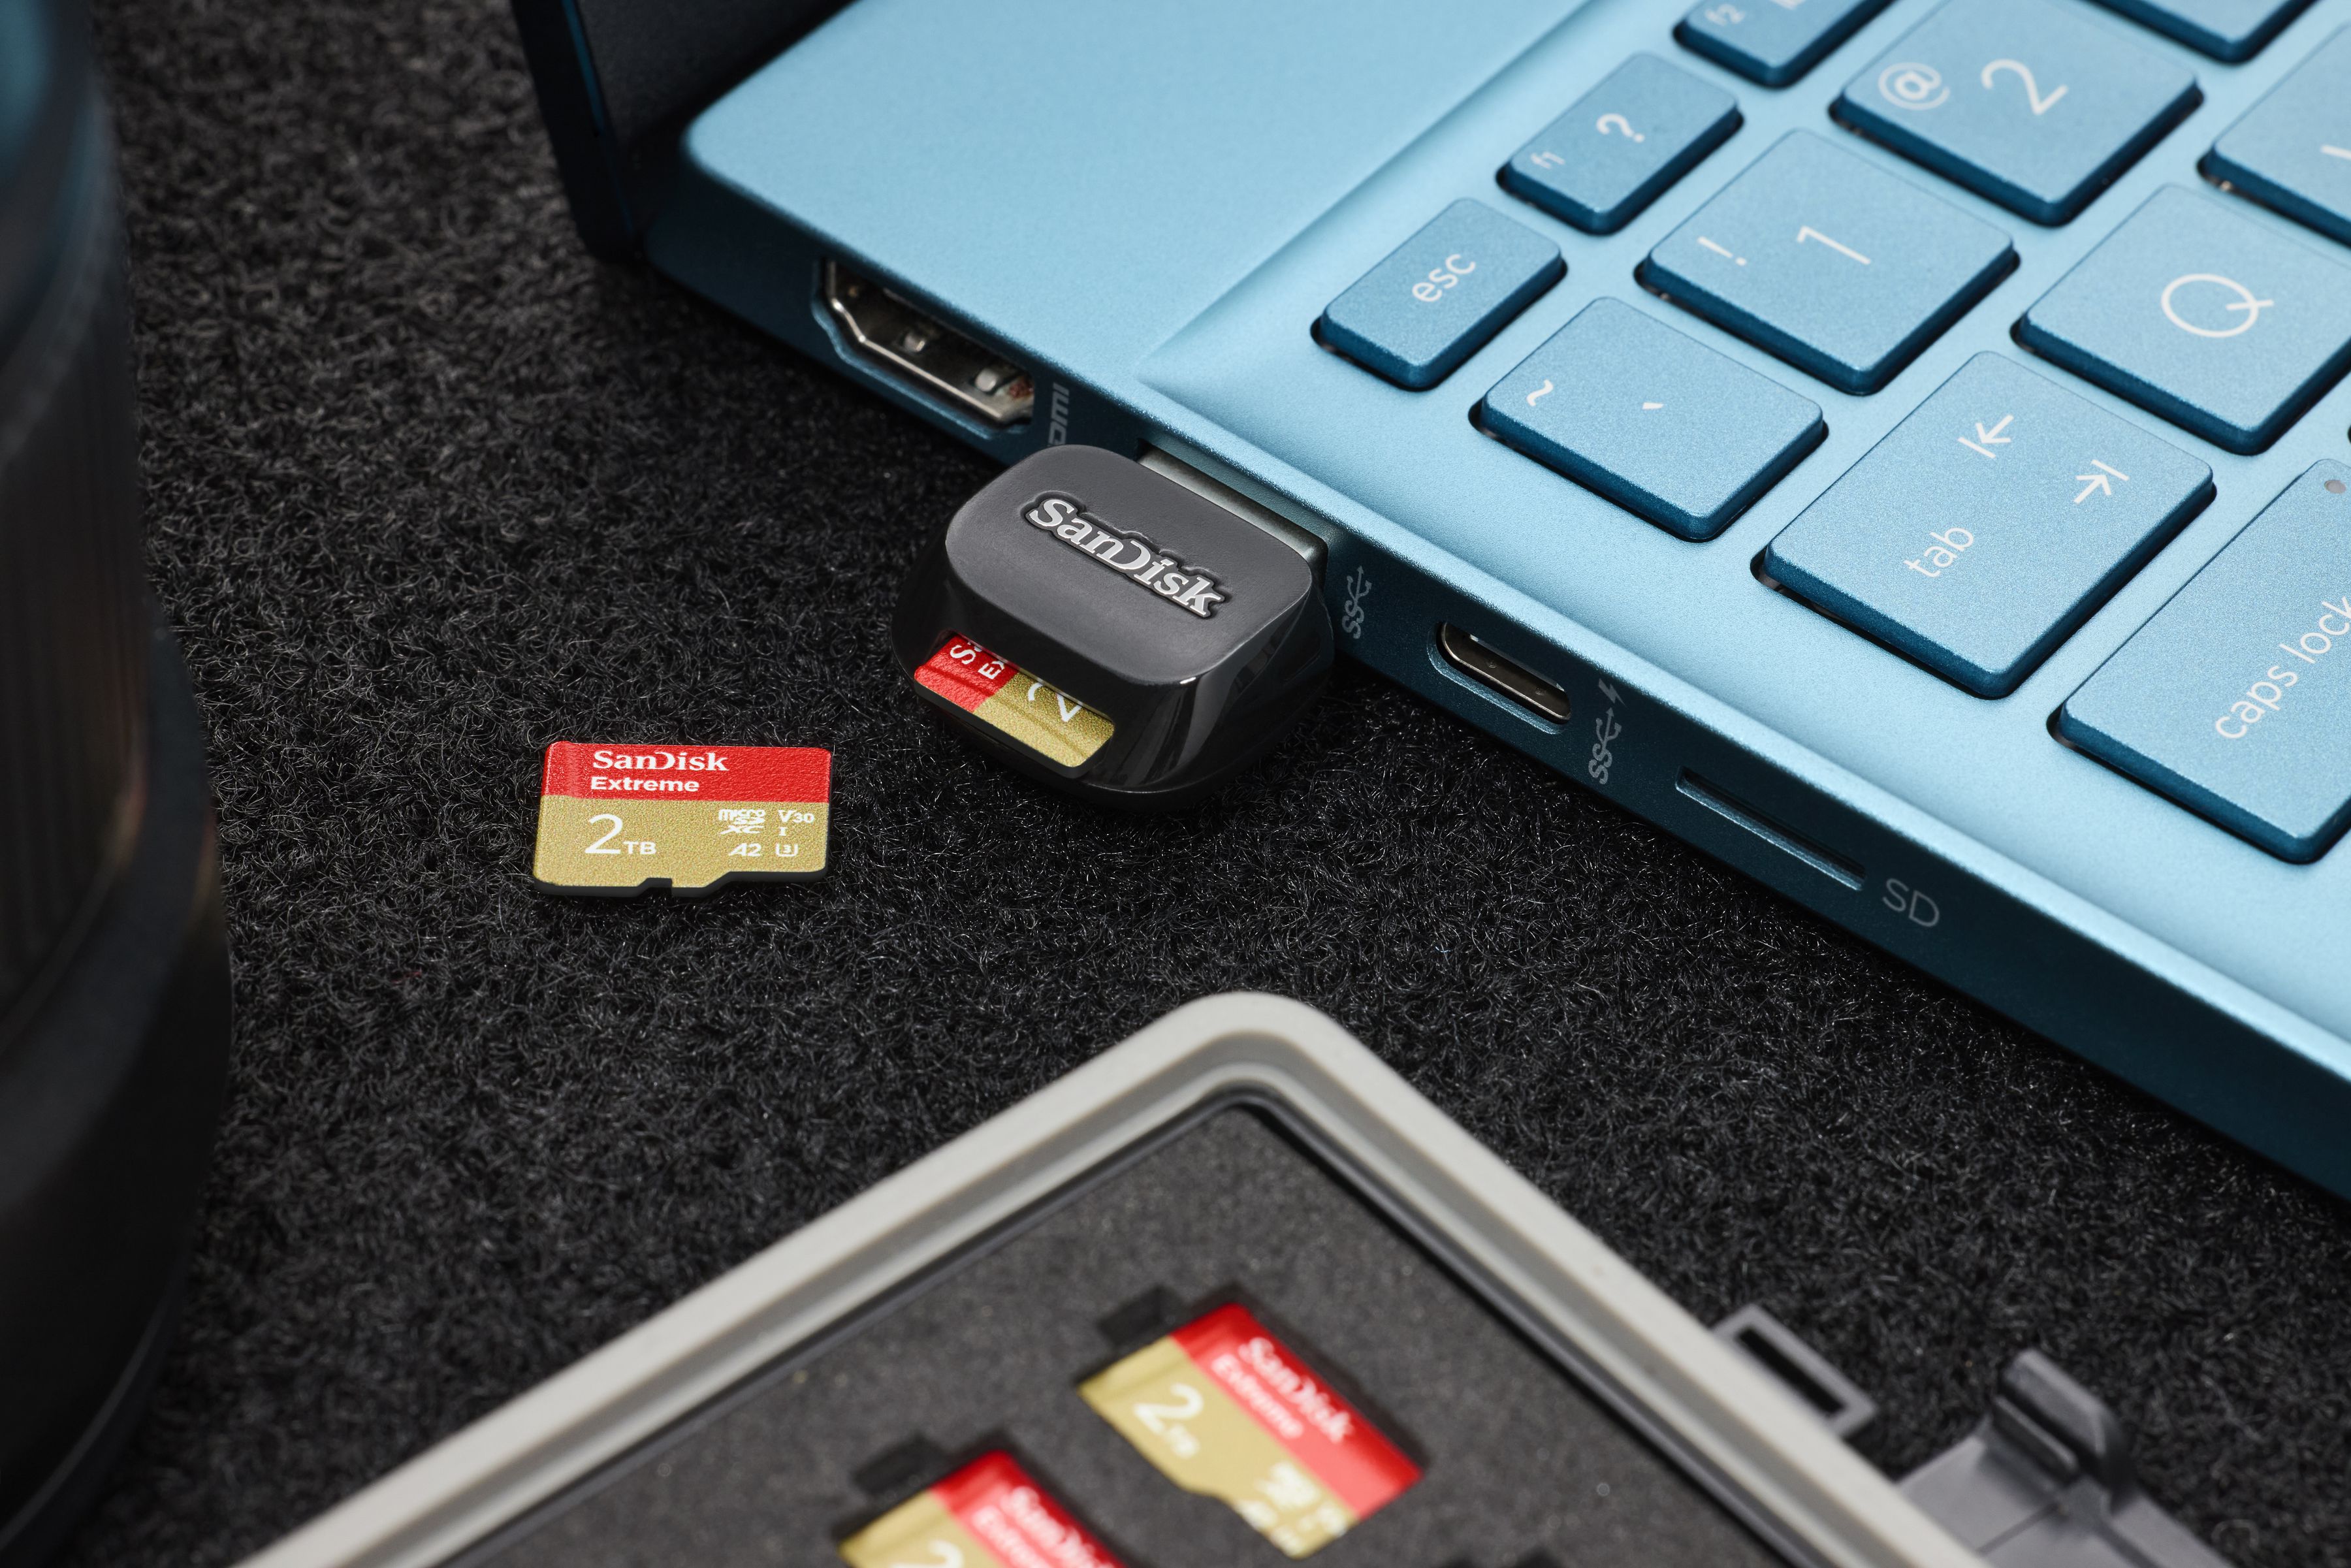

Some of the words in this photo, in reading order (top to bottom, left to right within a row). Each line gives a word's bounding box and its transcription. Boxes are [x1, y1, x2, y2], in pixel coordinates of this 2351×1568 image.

[1878, 63, 1950, 110] @
[1981, 59, 2069, 115] 2
[1596, 113, 1645, 143] ?
[1697, 236, 1748, 266] !
[1797, 226, 1872, 264] 1
[1412, 253, 1476, 302] esc
[2160, 273, 2274, 338] Q
[1047, 382, 1070, 447] DMI
[1028, 497, 1224, 618] SanDisk
[1904, 526, 1974, 579] tab
[2215, 665, 2299, 739] caps
[2279, 596, 2351, 664] lock
[591, 776, 699, 792] Extreme
[592, 750, 729, 771] SanDisk
[778, 809, 815, 824] V30
[728, 842, 762, 857] A2
[1881, 878, 1941, 929] SD
